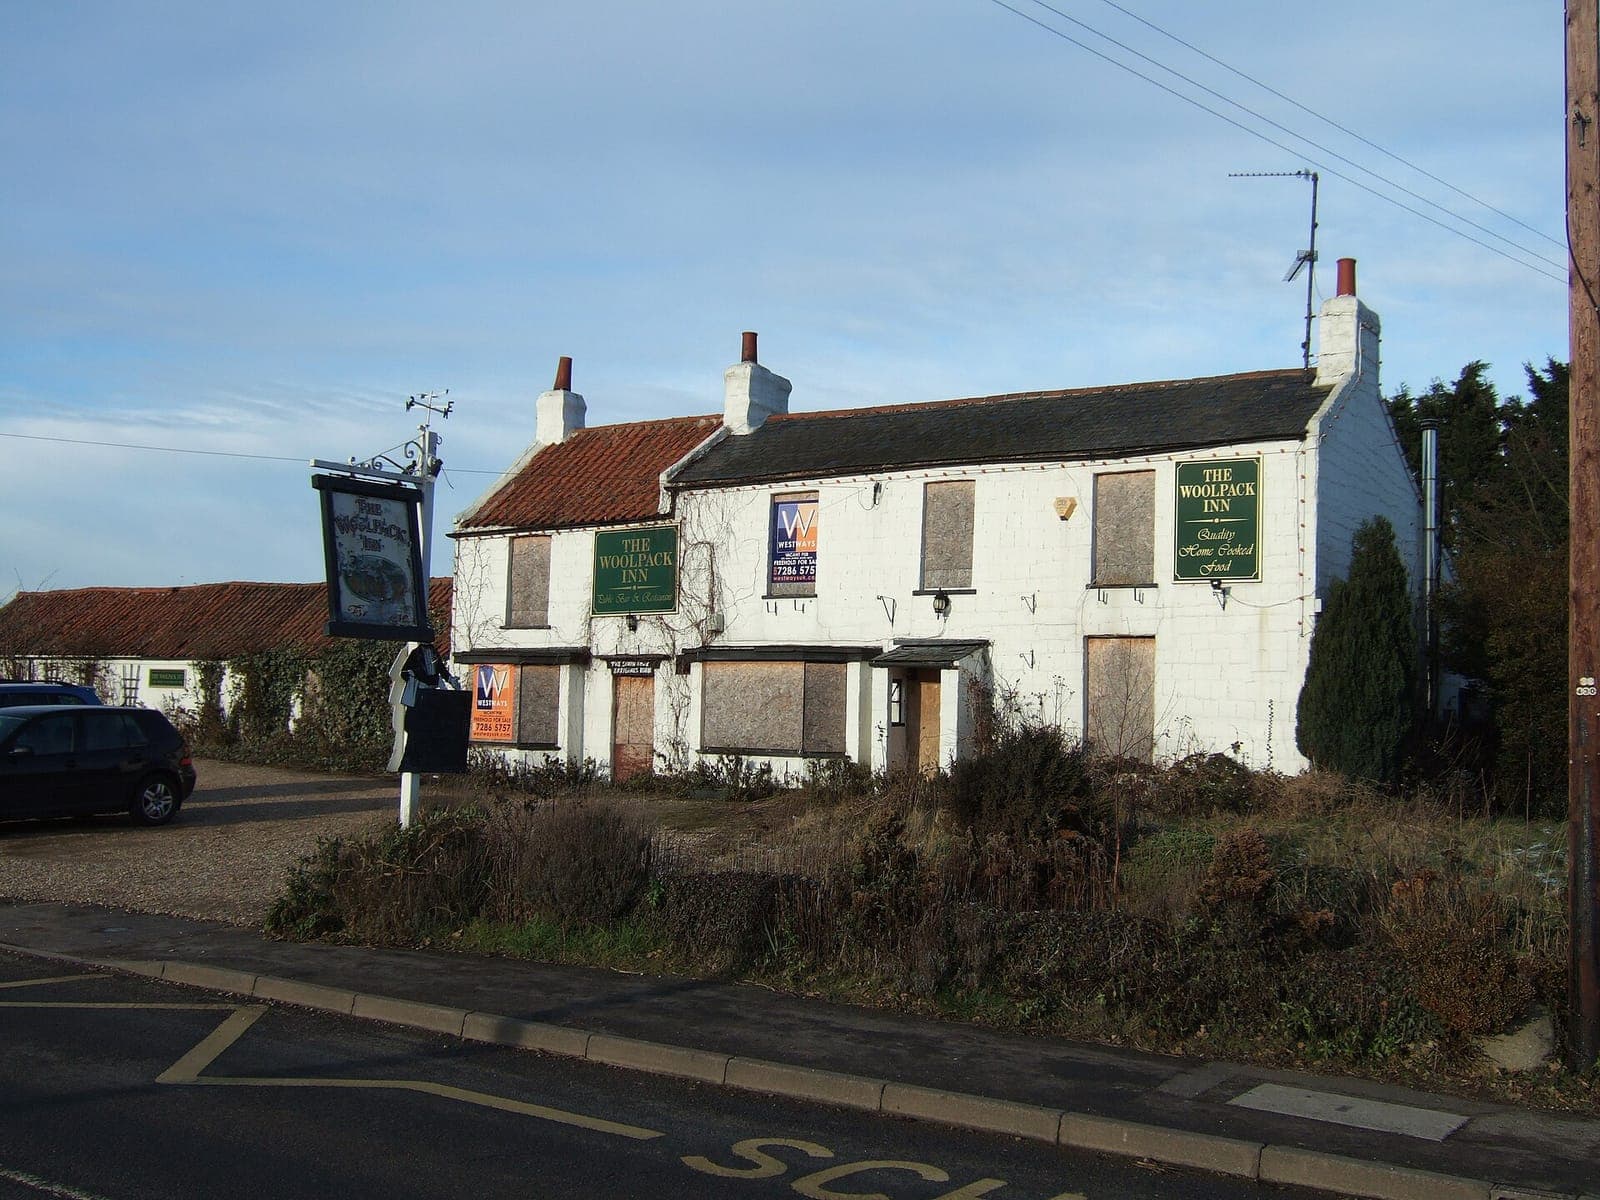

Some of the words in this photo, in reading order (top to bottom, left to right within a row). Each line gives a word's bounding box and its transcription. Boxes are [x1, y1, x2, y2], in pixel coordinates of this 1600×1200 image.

[1203, 468, 1232, 483] THE
[1179, 482, 1256, 499] WOOLPACK
[1203, 498, 1232, 513] INN
[335, 513, 408, 544] WOOLPACK
[1197, 527, 1236, 544] Quality
[622, 538, 650, 553] THE
[778, 541, 816, 549] WESTWAYS
[1178, 543, 1214, 557] Home
[1217, 543, 1254, 557] Cooked
[599, 552, 673, 569] WOOLPACK
[1199, 559, 1232, 577] Food
[621, 568, 649, 584] INN
[777, 566, 797, 576] 7286
[476, 723, 492, 731] 7286
[495, 724, 511, 732] 5757
